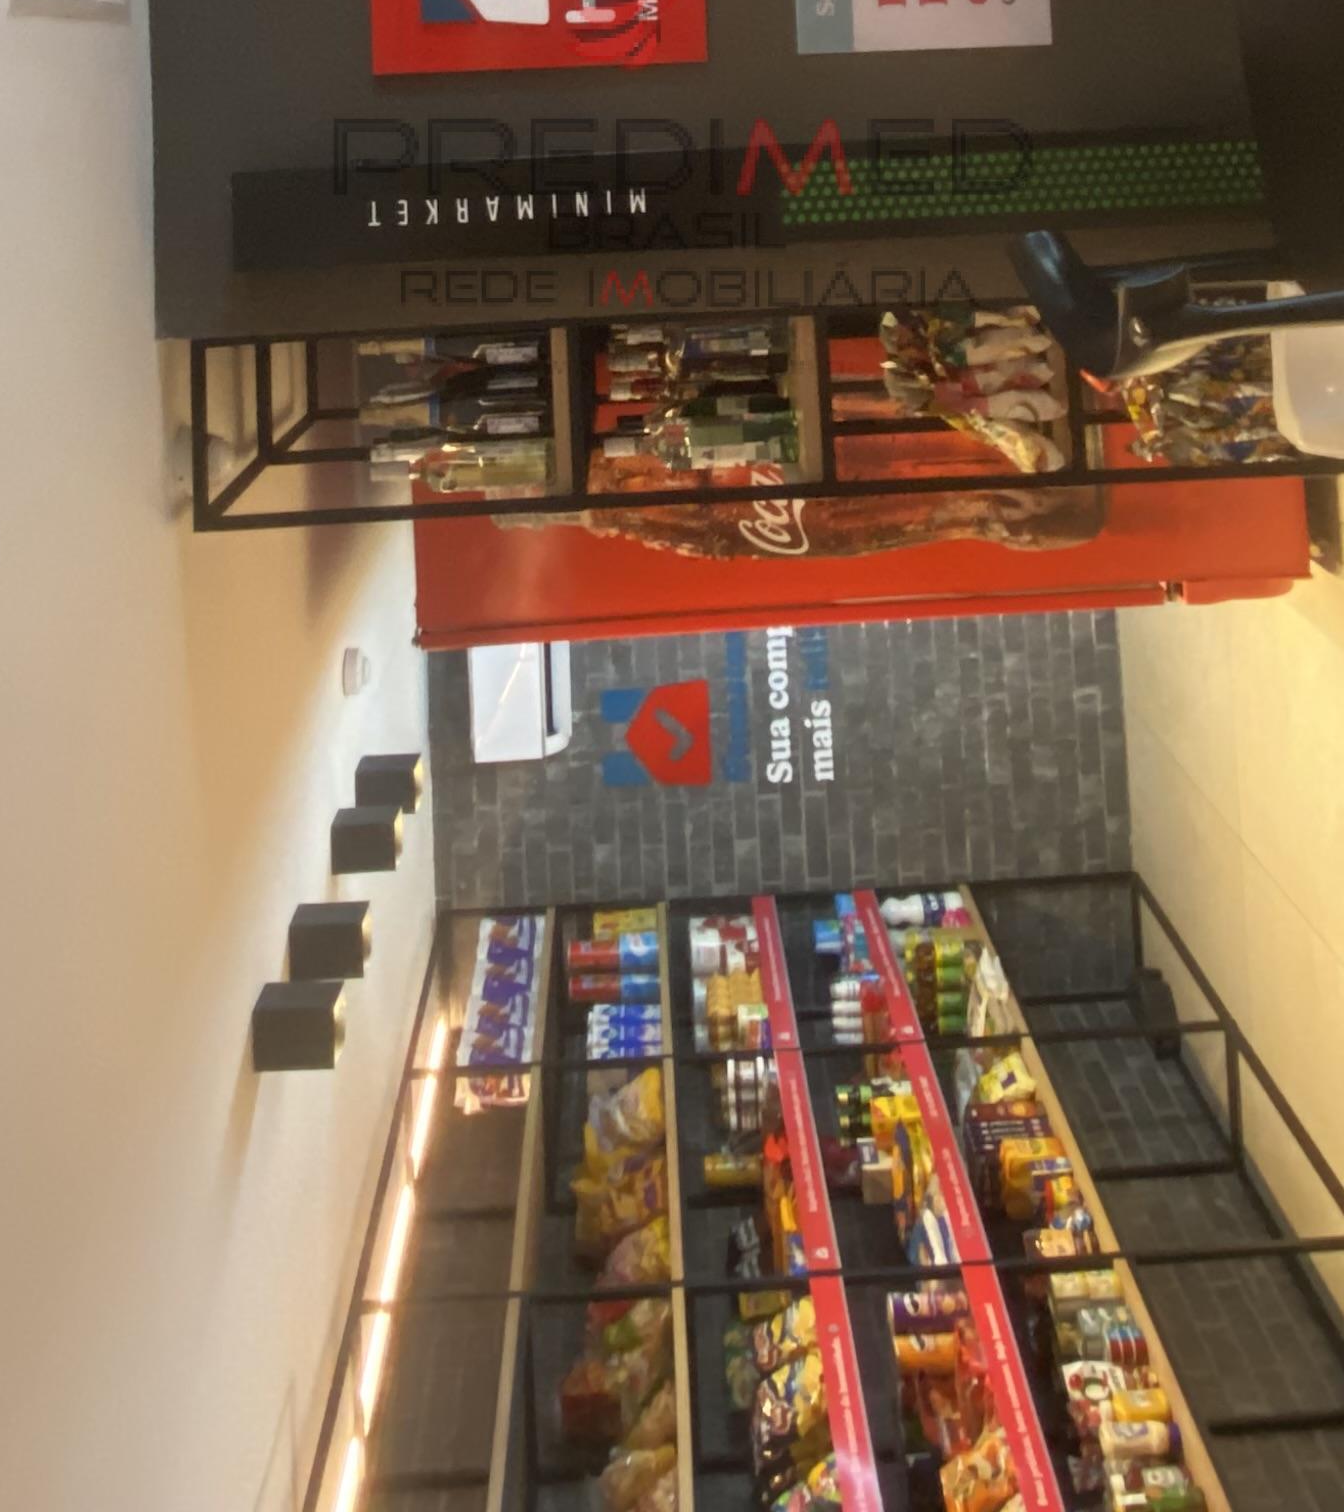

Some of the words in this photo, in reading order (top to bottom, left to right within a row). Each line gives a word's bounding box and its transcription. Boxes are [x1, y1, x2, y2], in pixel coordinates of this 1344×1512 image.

[365, 189, 647, 228] MINIMARKET
[766, 717, 793, 783] Sua
[803, 700, 834, 781] mais
